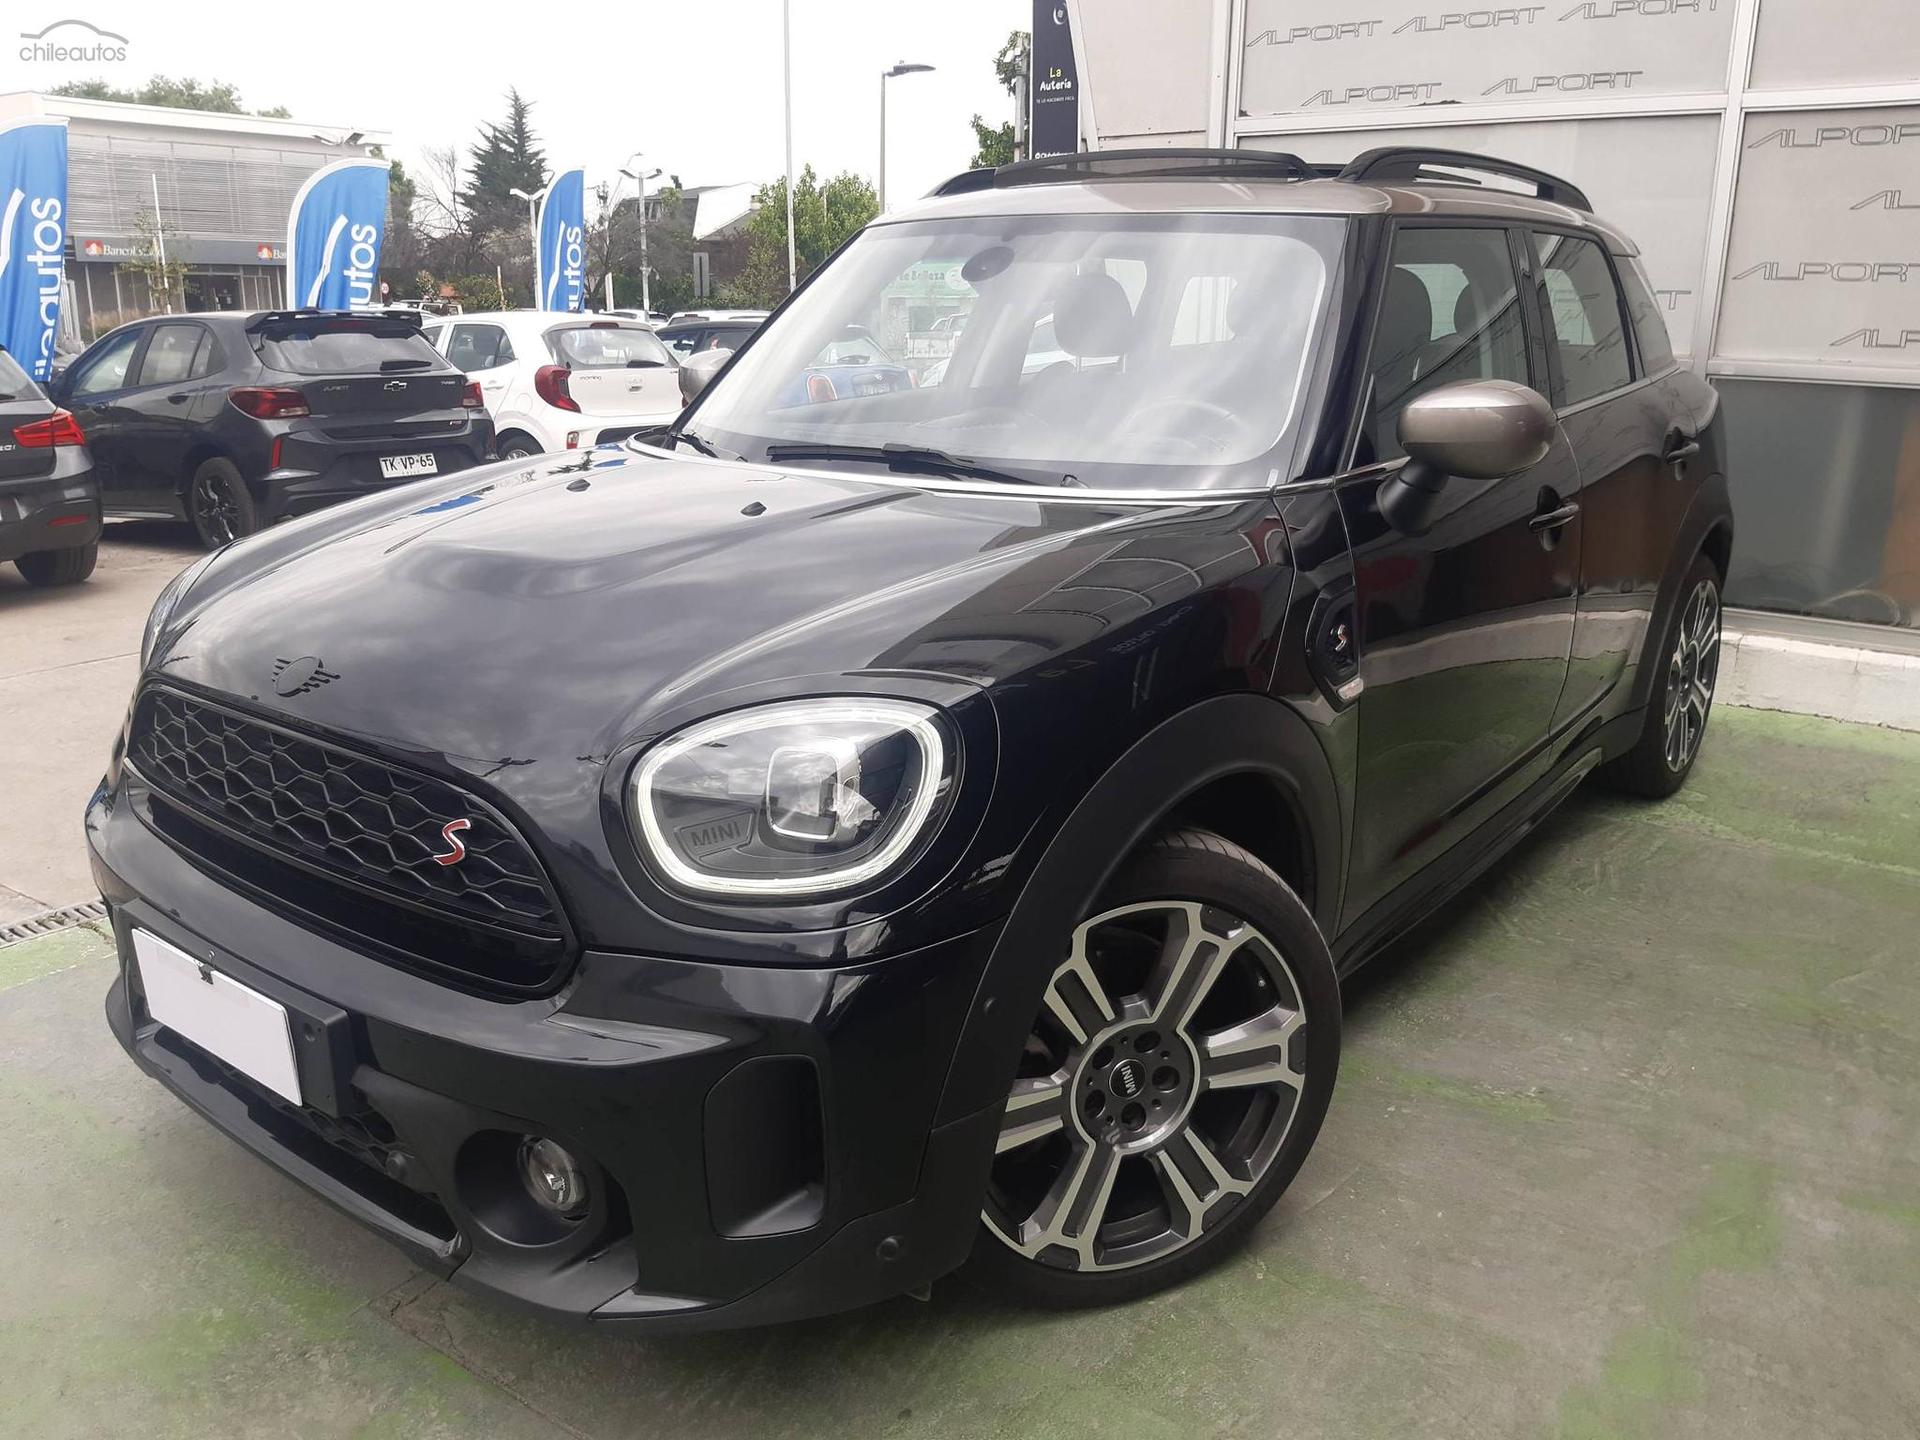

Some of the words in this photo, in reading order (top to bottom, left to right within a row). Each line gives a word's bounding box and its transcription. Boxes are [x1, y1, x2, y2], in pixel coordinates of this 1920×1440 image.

[1246, 20, 1383, 47] ALPORT
[1392, 7, 1546, 34] ALPORT
[1050, 67, 1061, 78] La
[1301, 82, 1442, 107] ALPORT
[1481, 71, 1643, 96] ALPORT
[344, 224, 377, 311] utos
[433, 818, 471, 865] S
[691, 821, 741, 846] MINI
[1120, 1065, 1137, 1094] MINI
